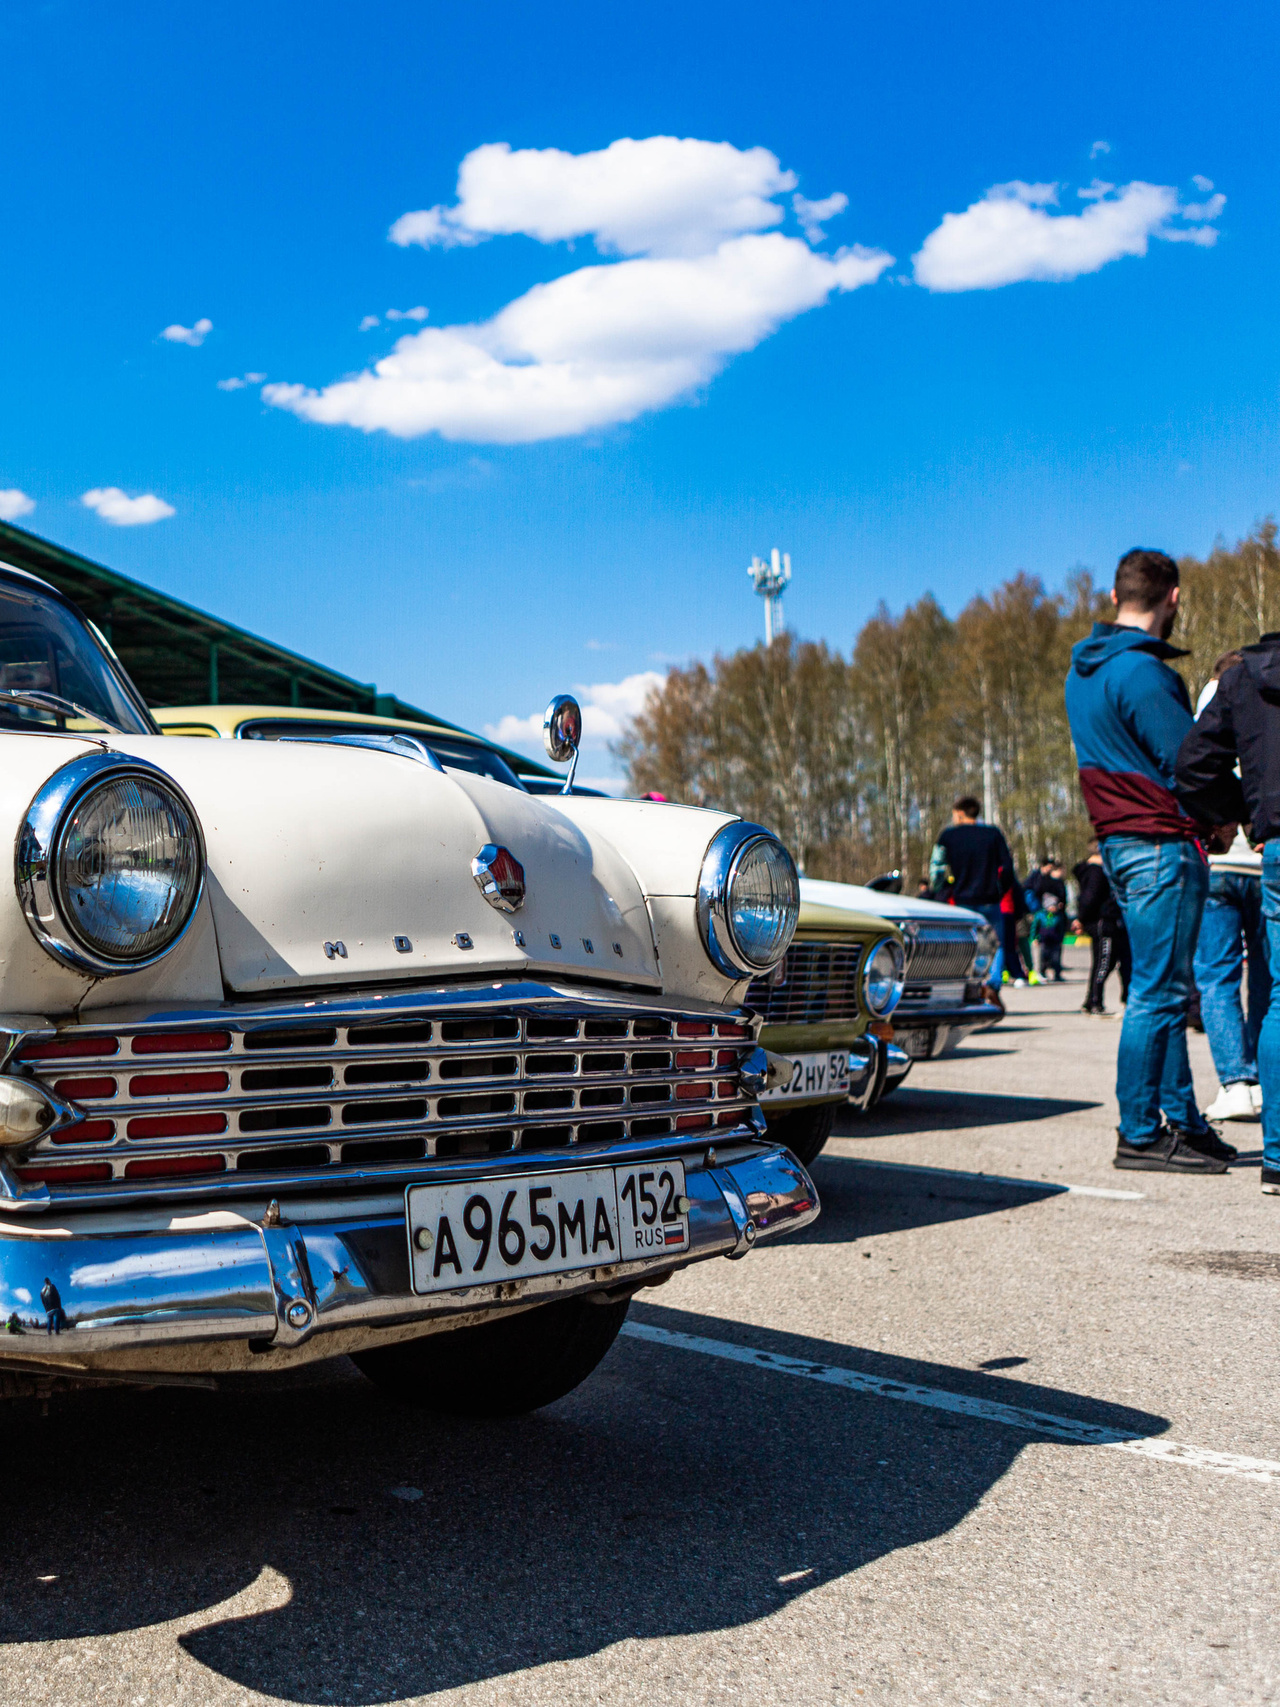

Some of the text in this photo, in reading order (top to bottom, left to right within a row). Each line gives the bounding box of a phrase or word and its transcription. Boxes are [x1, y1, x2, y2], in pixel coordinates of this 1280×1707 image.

[322, 931, 624, 961] МОСКВИЧ
[830, 1054, 846, 1080] 52
[432, 1170, 678, 1278] А965МА 152
[634, 1227, 664, 1249] RUS
